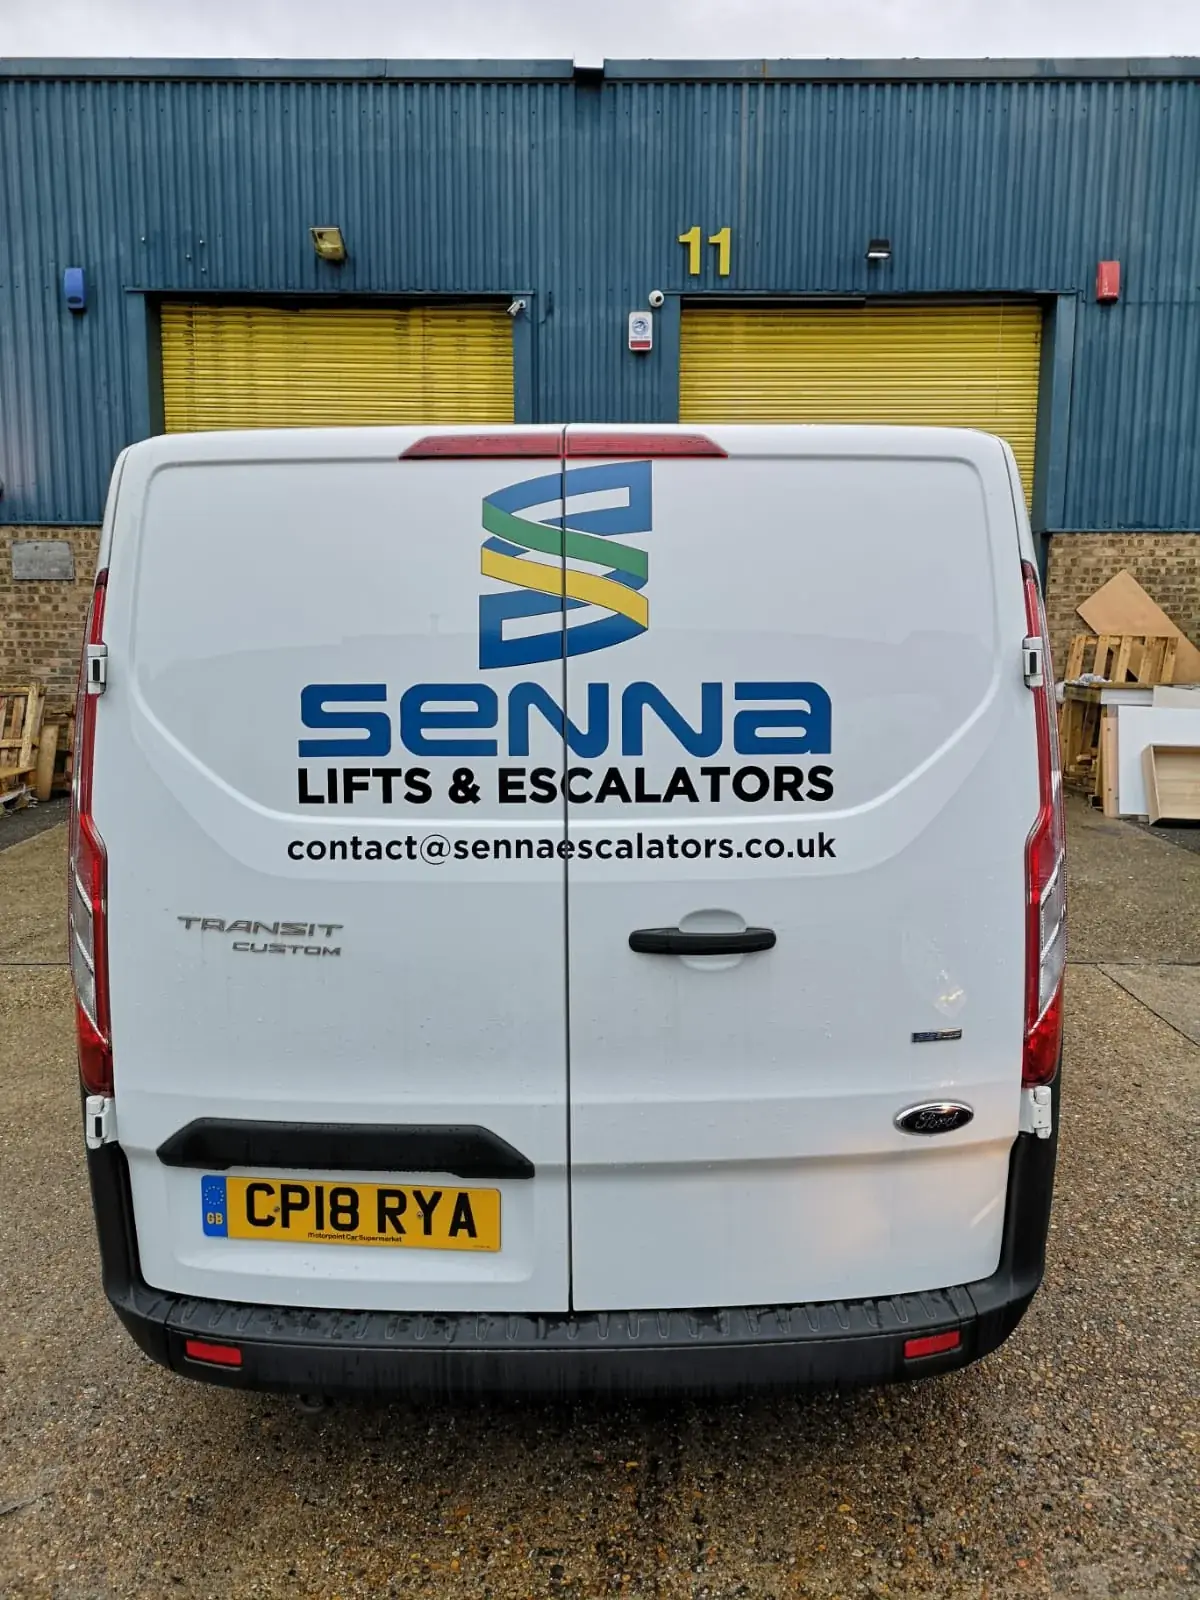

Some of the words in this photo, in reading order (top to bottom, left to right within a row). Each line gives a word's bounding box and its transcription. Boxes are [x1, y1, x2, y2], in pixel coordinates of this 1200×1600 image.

[678, 226, 731, 276] 11
[298, 767, 432, 804] LIFTS
[448, 767, 481, 804] &
[498, 765, 834, 803] ESCALATORS
[287, 832, 837, 866] contact@sennaescalators.co.uk
[177, 916, 344, 937] TRANSIT
[232, 942, 342, 956] CUSTOM
[914, 1111, 959, 1129] Ford
[206, 1212, 223, 1225] GB
[245, 1182, 360, 1232] CP18
[376, 1189, 478, 1238] RYA
